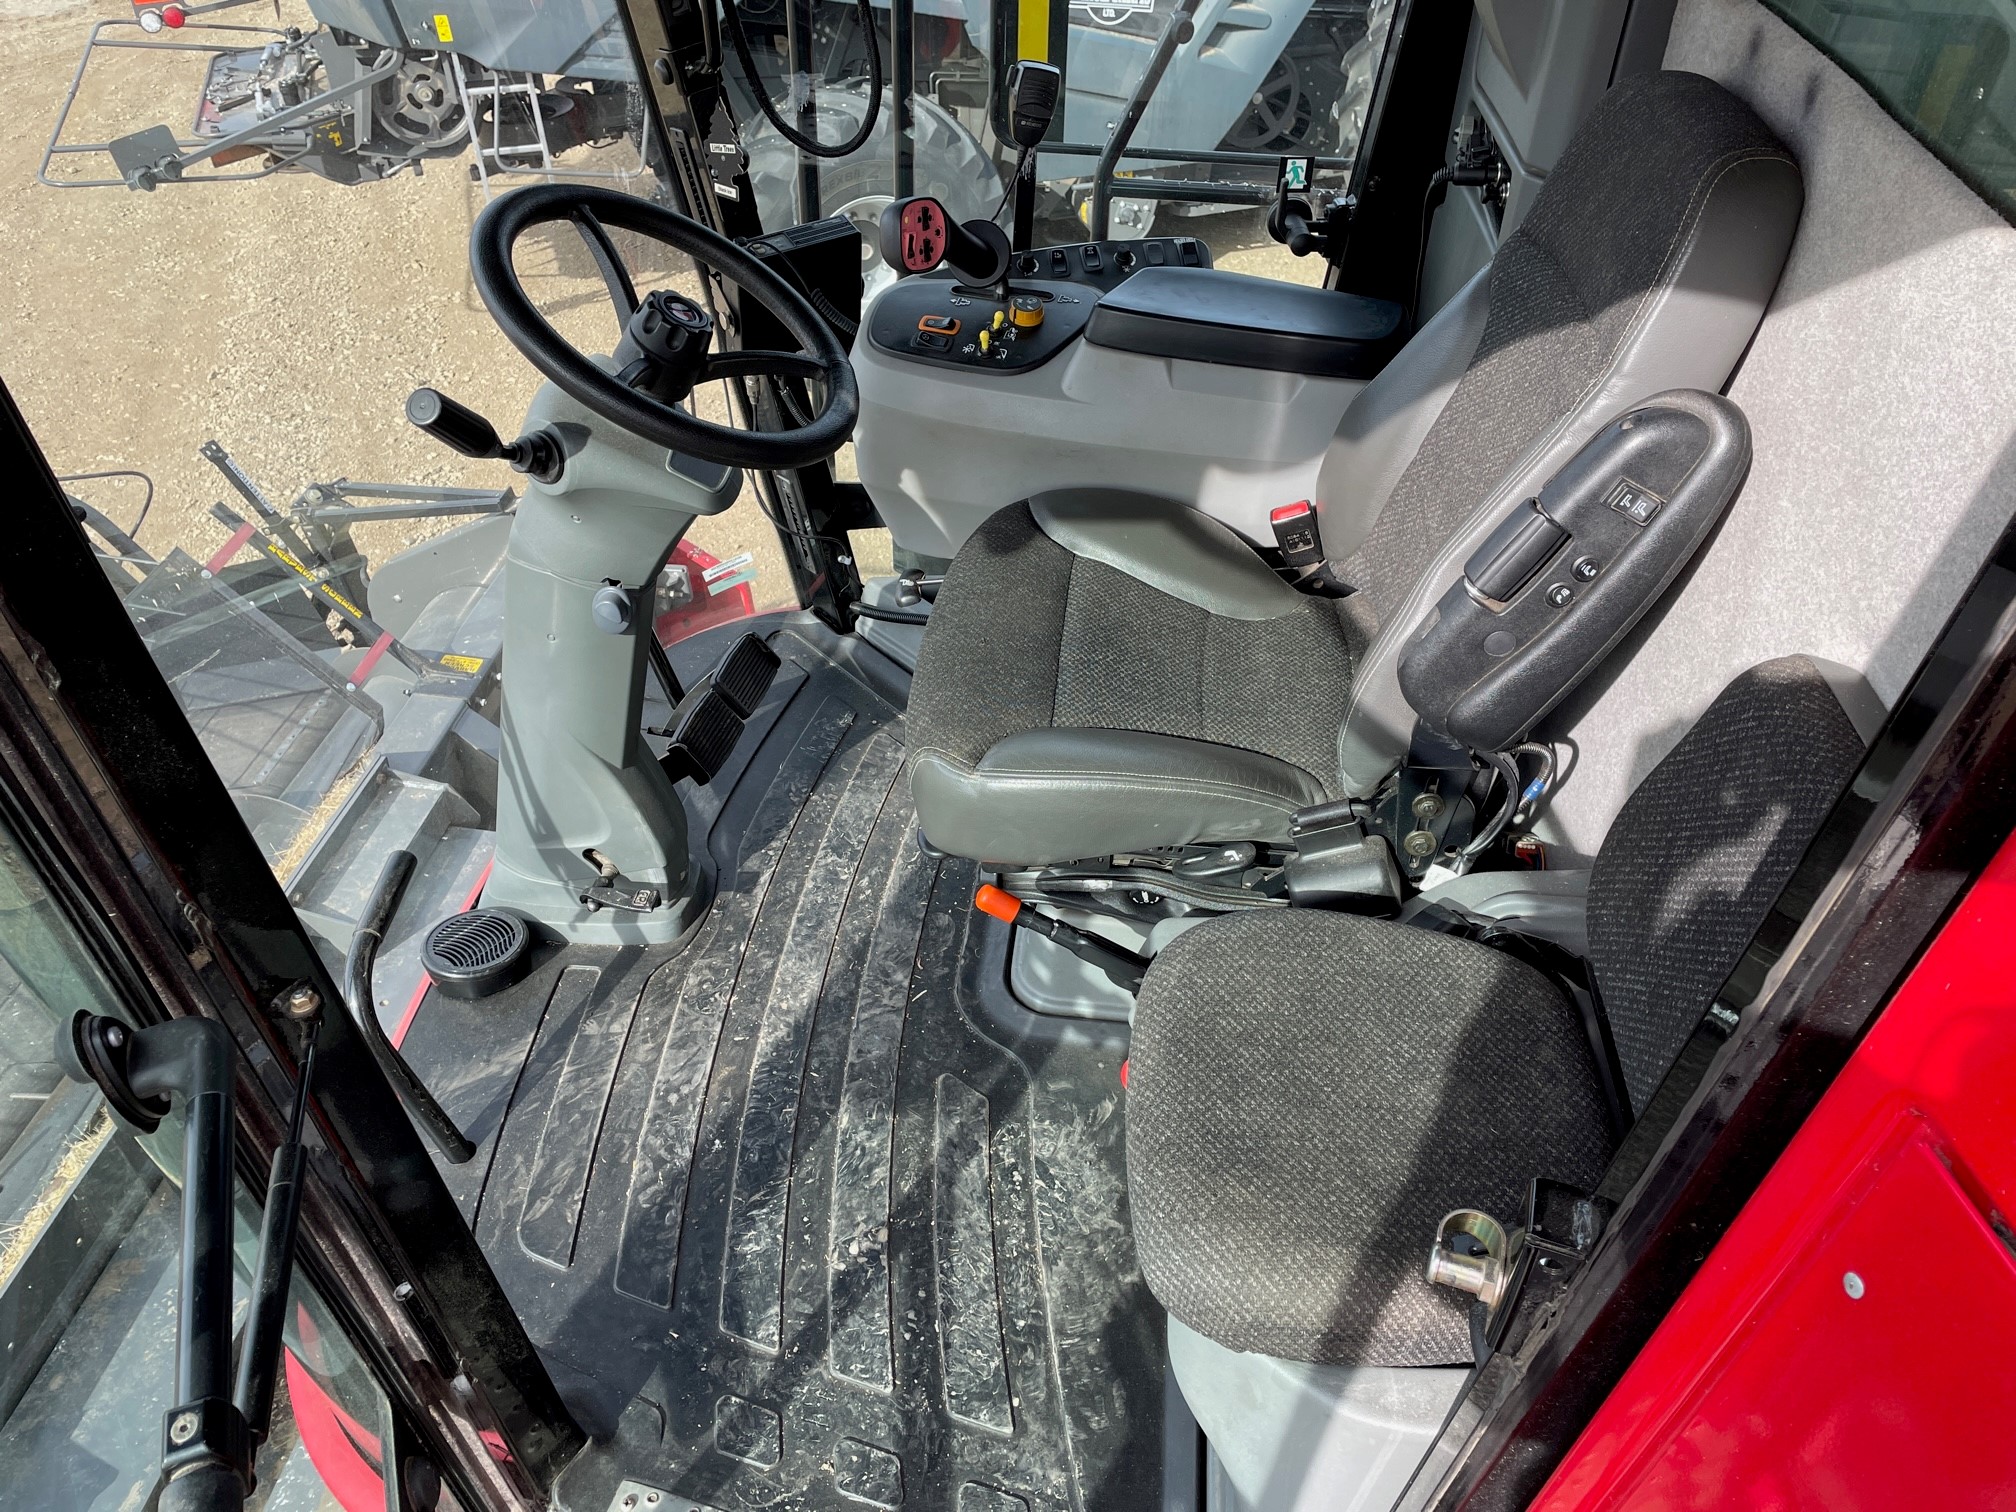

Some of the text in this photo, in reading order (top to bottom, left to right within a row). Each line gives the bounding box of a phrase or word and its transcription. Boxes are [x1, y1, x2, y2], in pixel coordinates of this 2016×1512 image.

[722, 144, 734, 152] Trees
[267, 543, 364, 619] HARVEST SCREEN
